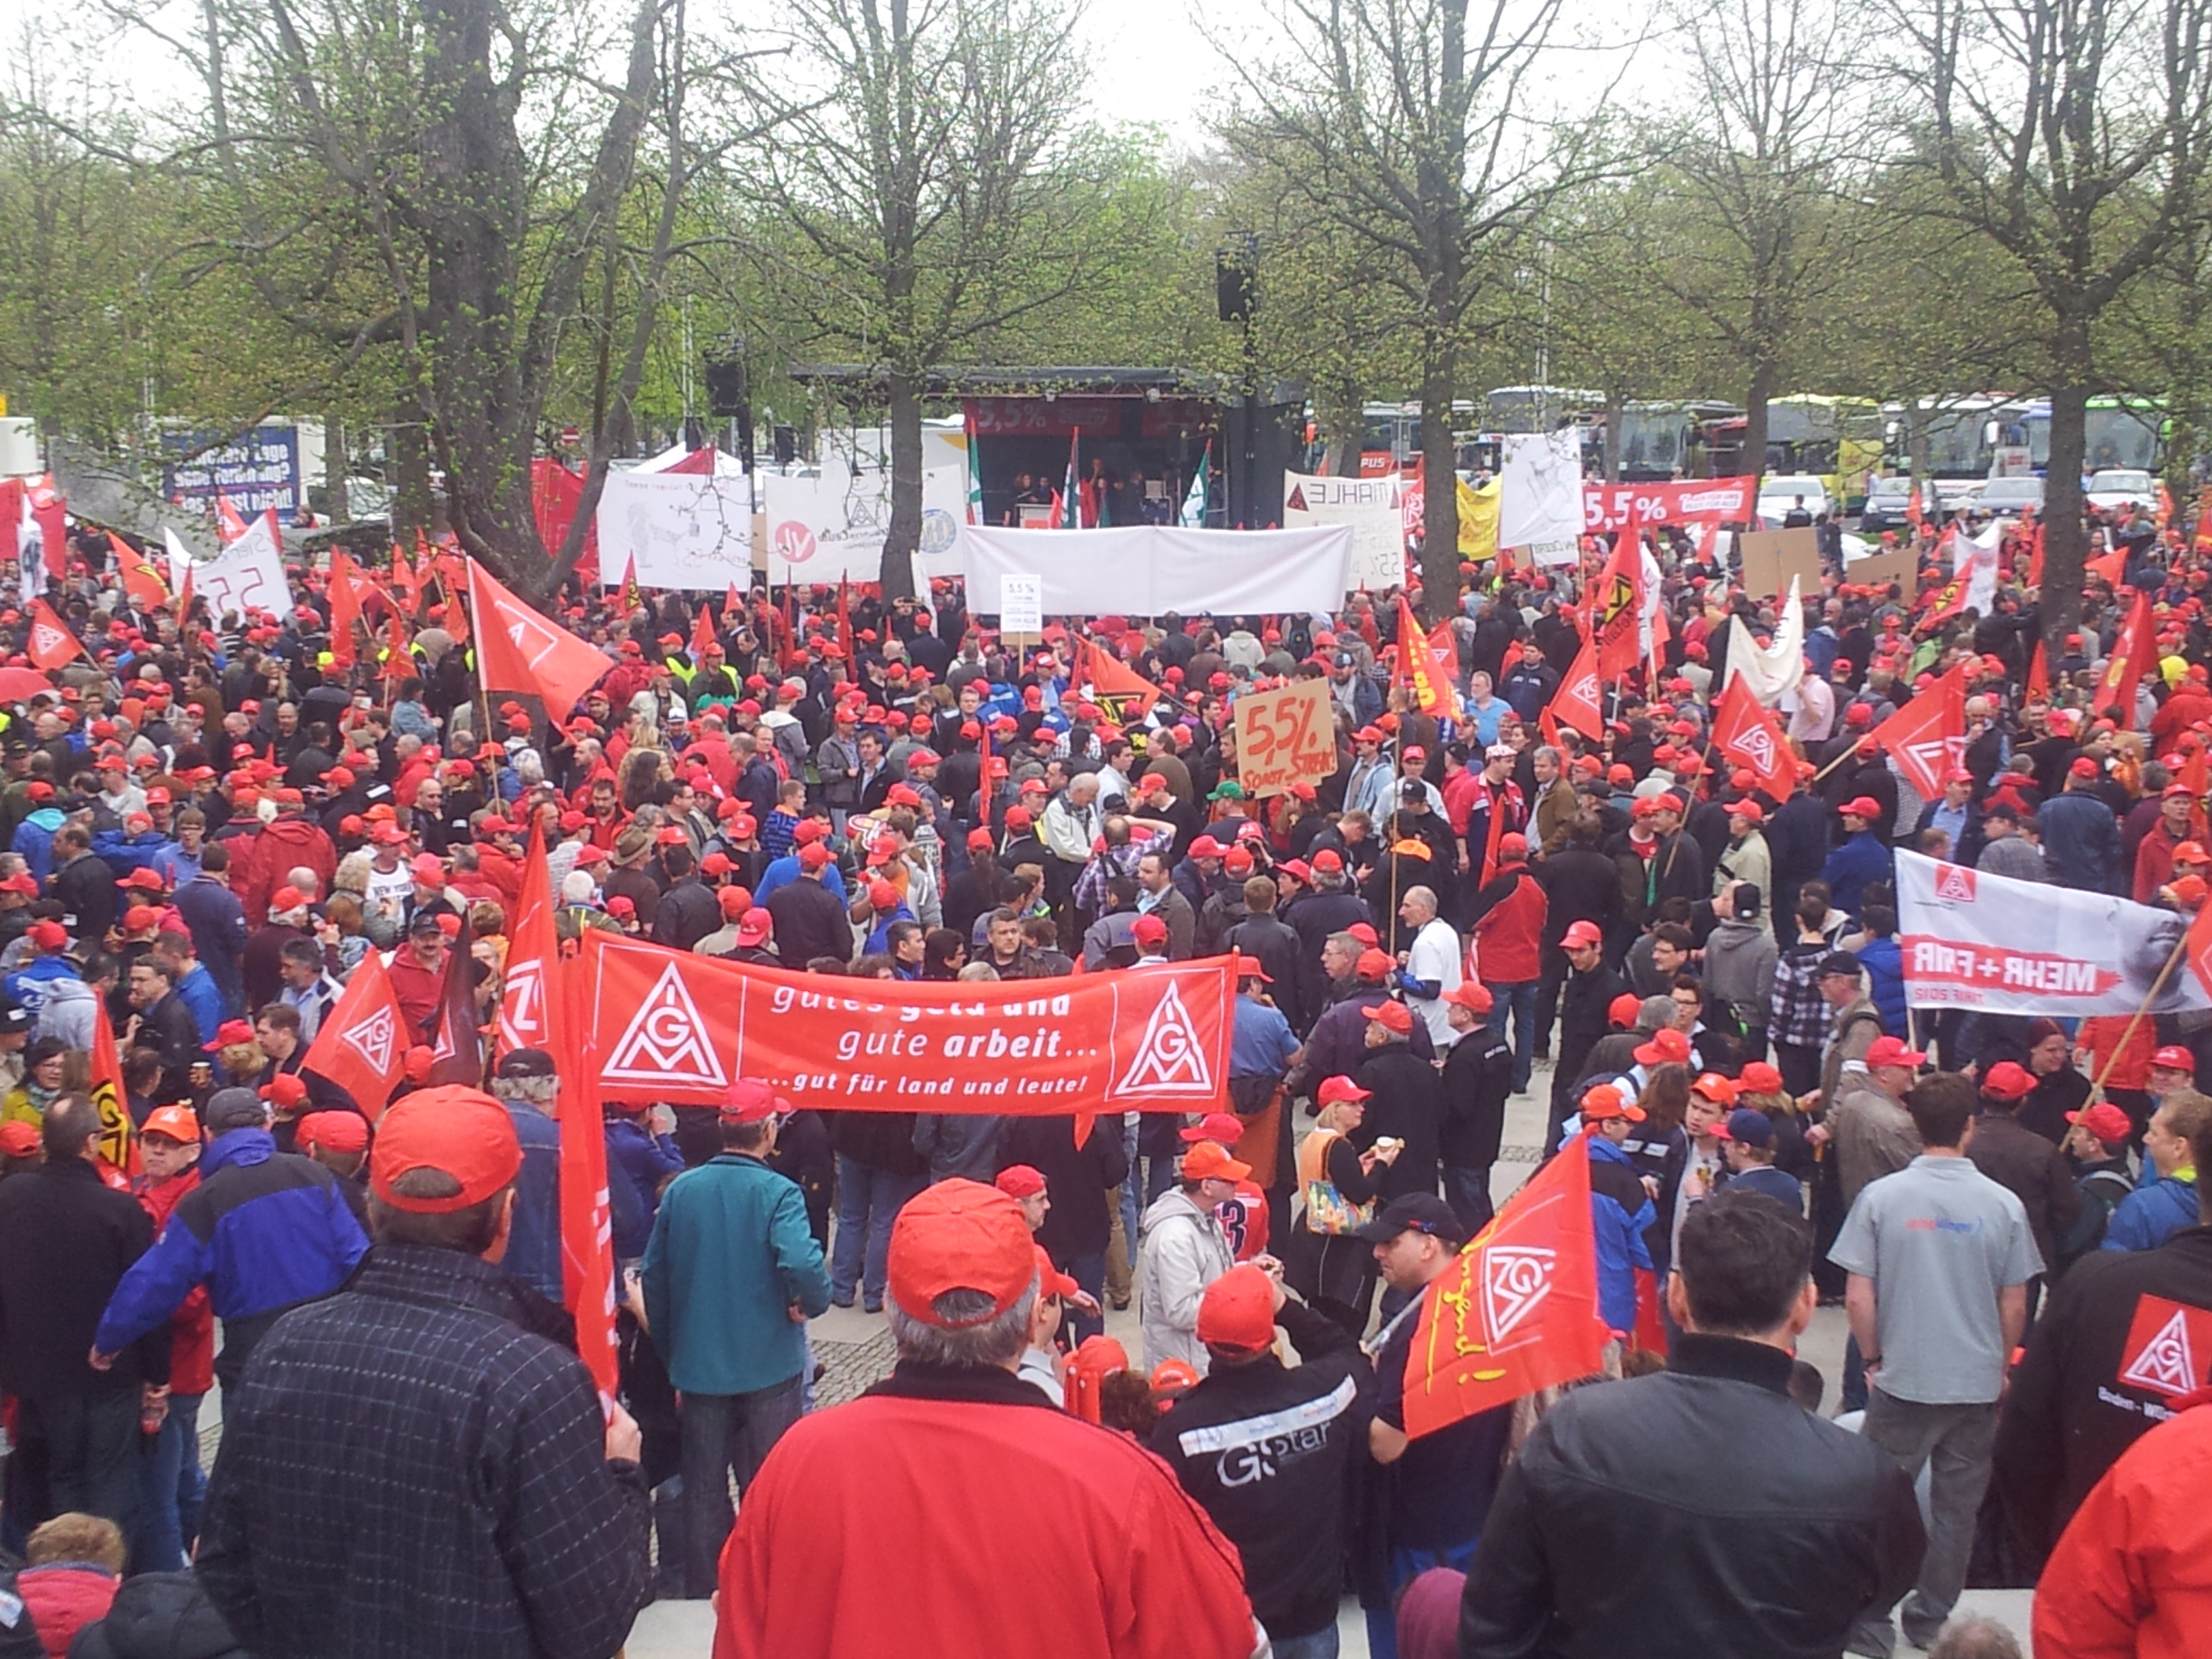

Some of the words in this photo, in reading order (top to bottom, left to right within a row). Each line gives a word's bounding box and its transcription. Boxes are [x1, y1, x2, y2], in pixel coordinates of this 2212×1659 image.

[1586, 491, 1667, 531] 5,5%
[1246, 696, 1317, 766] 5,5%
[373, 886, 391, 896] NEW
[835, 1028, 928, 1061] gute
[943, 1028, 1097, 1059] arbeit...
[845, 1072, 888, 1097] für
[897, 1076, 958, 1095] land
[963, 1076, 1009, 1096] und
[1017, 1076, 1088, 1094] leute!
